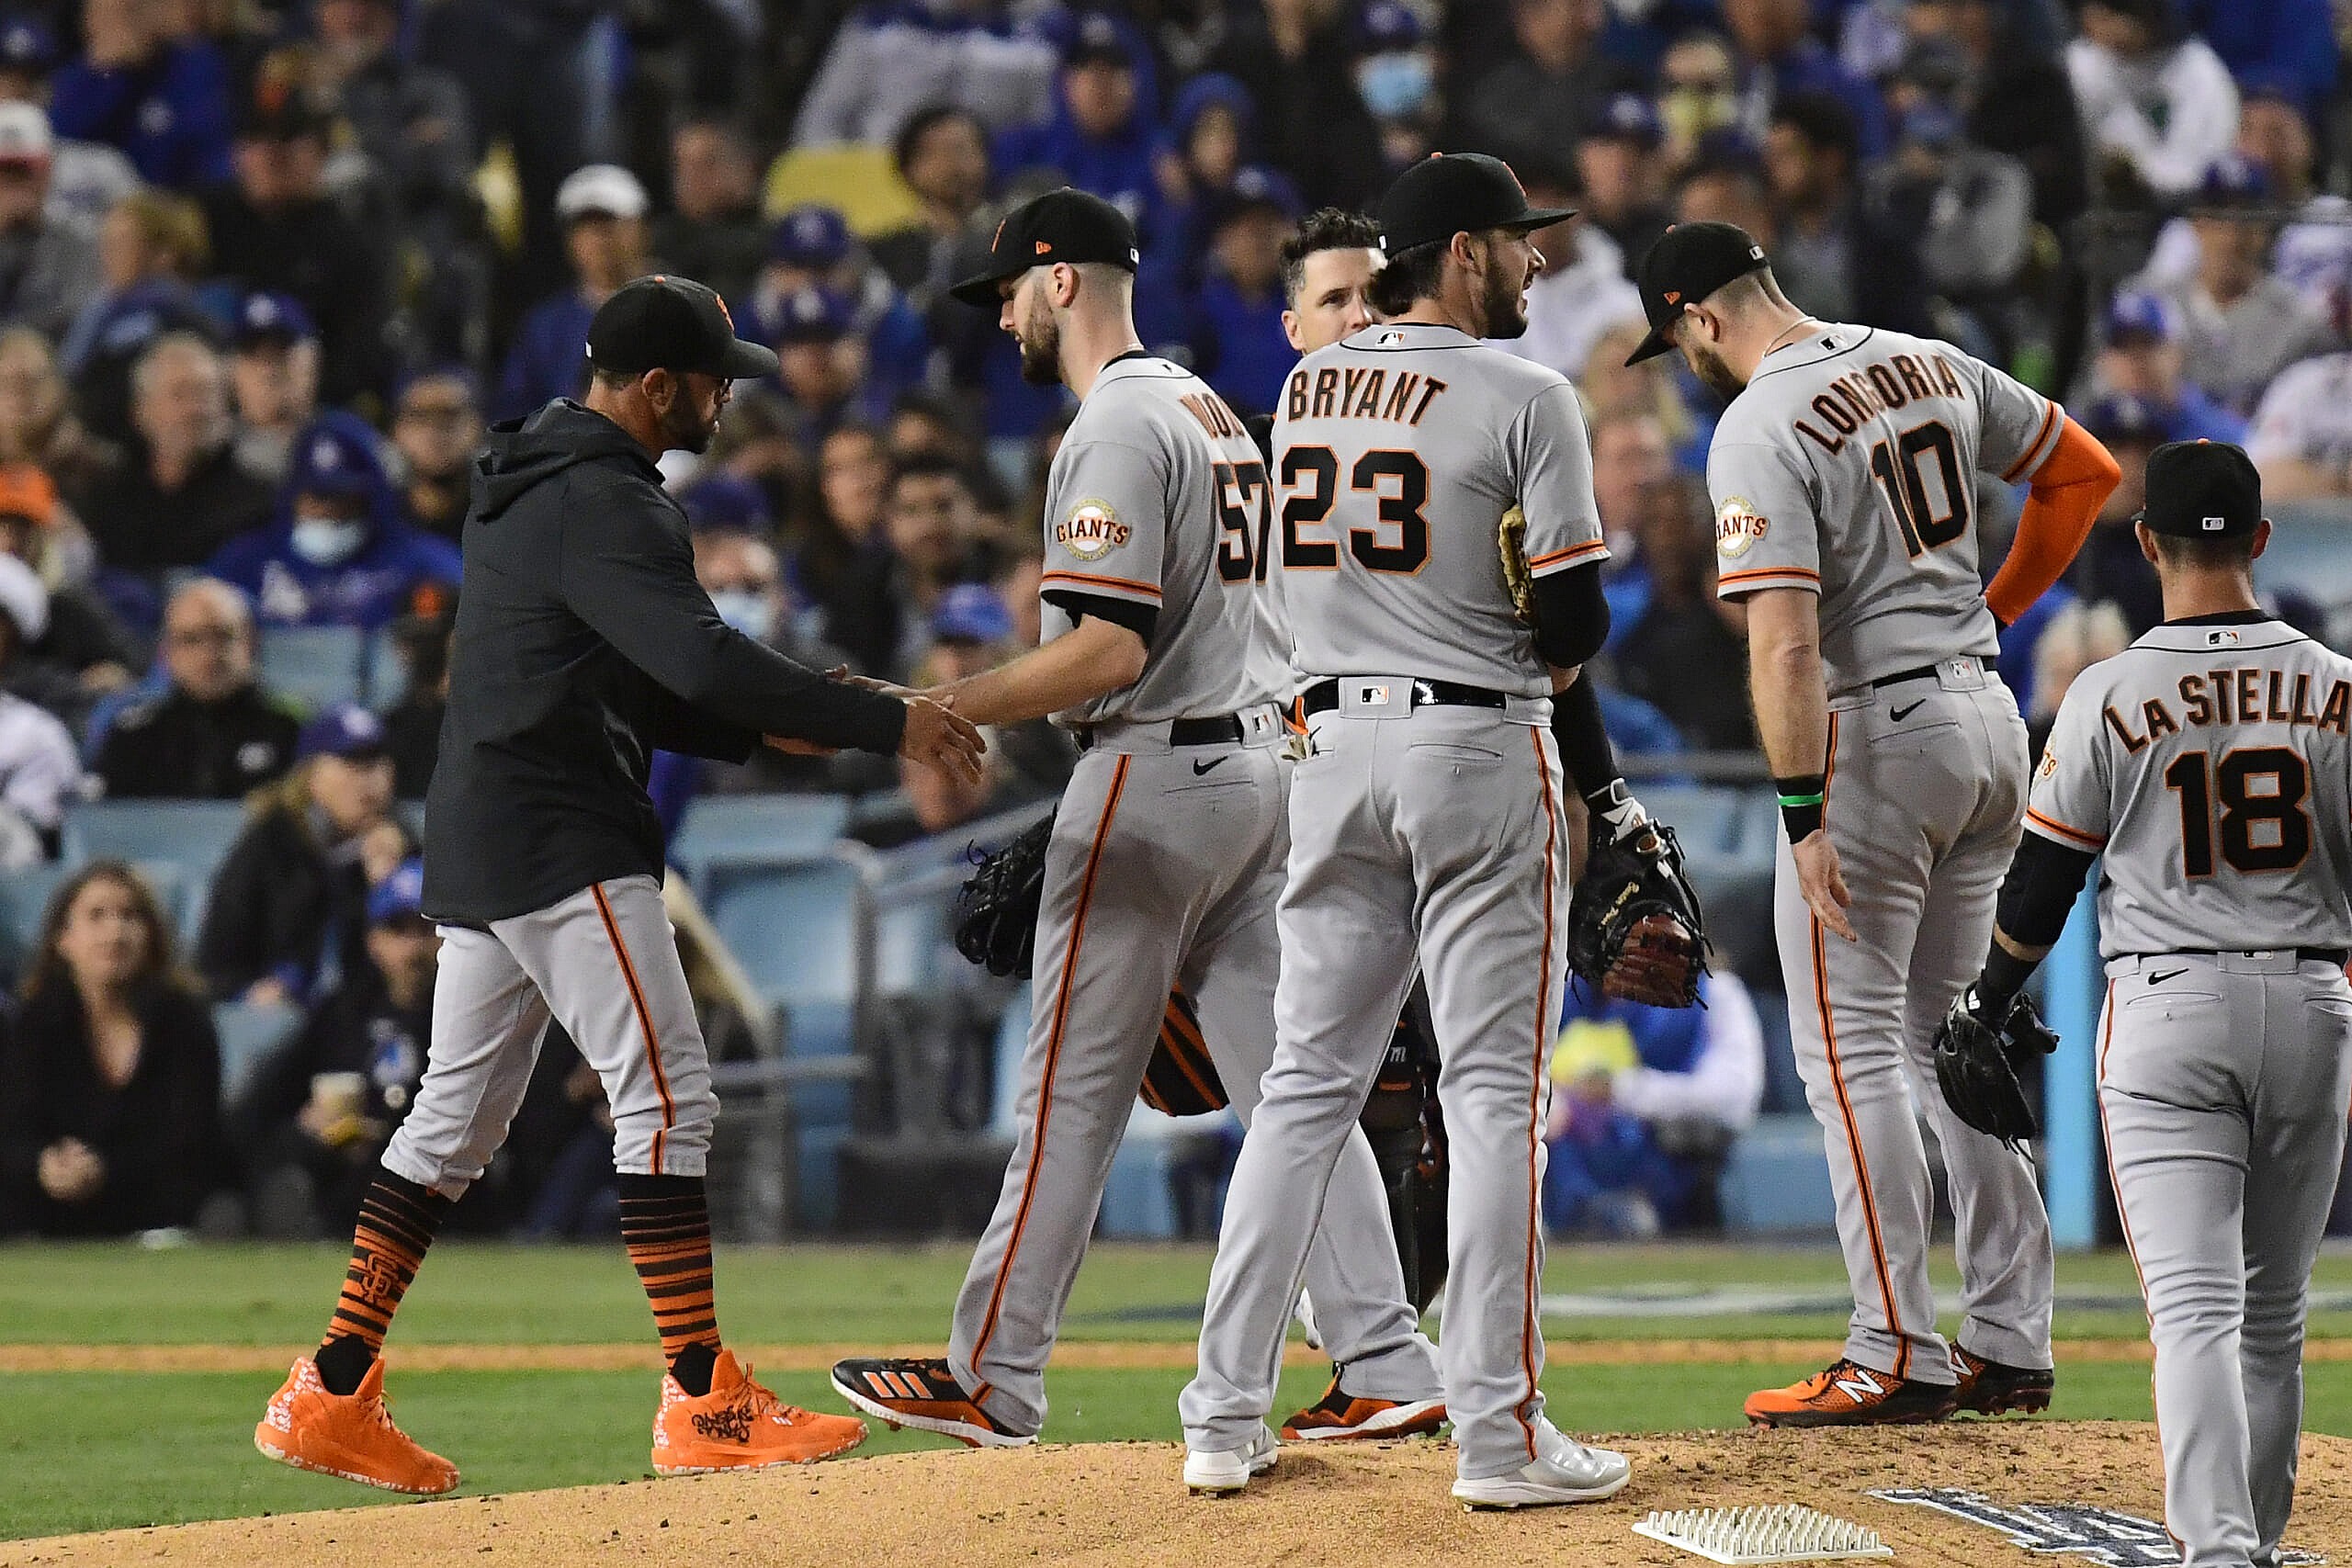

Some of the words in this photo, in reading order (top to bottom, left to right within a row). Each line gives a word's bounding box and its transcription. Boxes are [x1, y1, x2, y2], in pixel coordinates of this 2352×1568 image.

[1179, 392, 1245, 440] WOO
[1288, 367, 1449, 426] BRYANT
[1794, 353, 1966, 456] LONGORIA
[1055, 517, 1131, 546] GIANTS
[1213, 459, 1273, 585] 57
[1281, 444, 1431, 576] 23
[1716, 513, 1769, 541] IANTS
[1870, 419, 1971, 559] 10
[2103, 697, 2181, 756] LA
[2177, 669, 2352, 737] STELLA
[2165, 745, 2312, 879] 18
